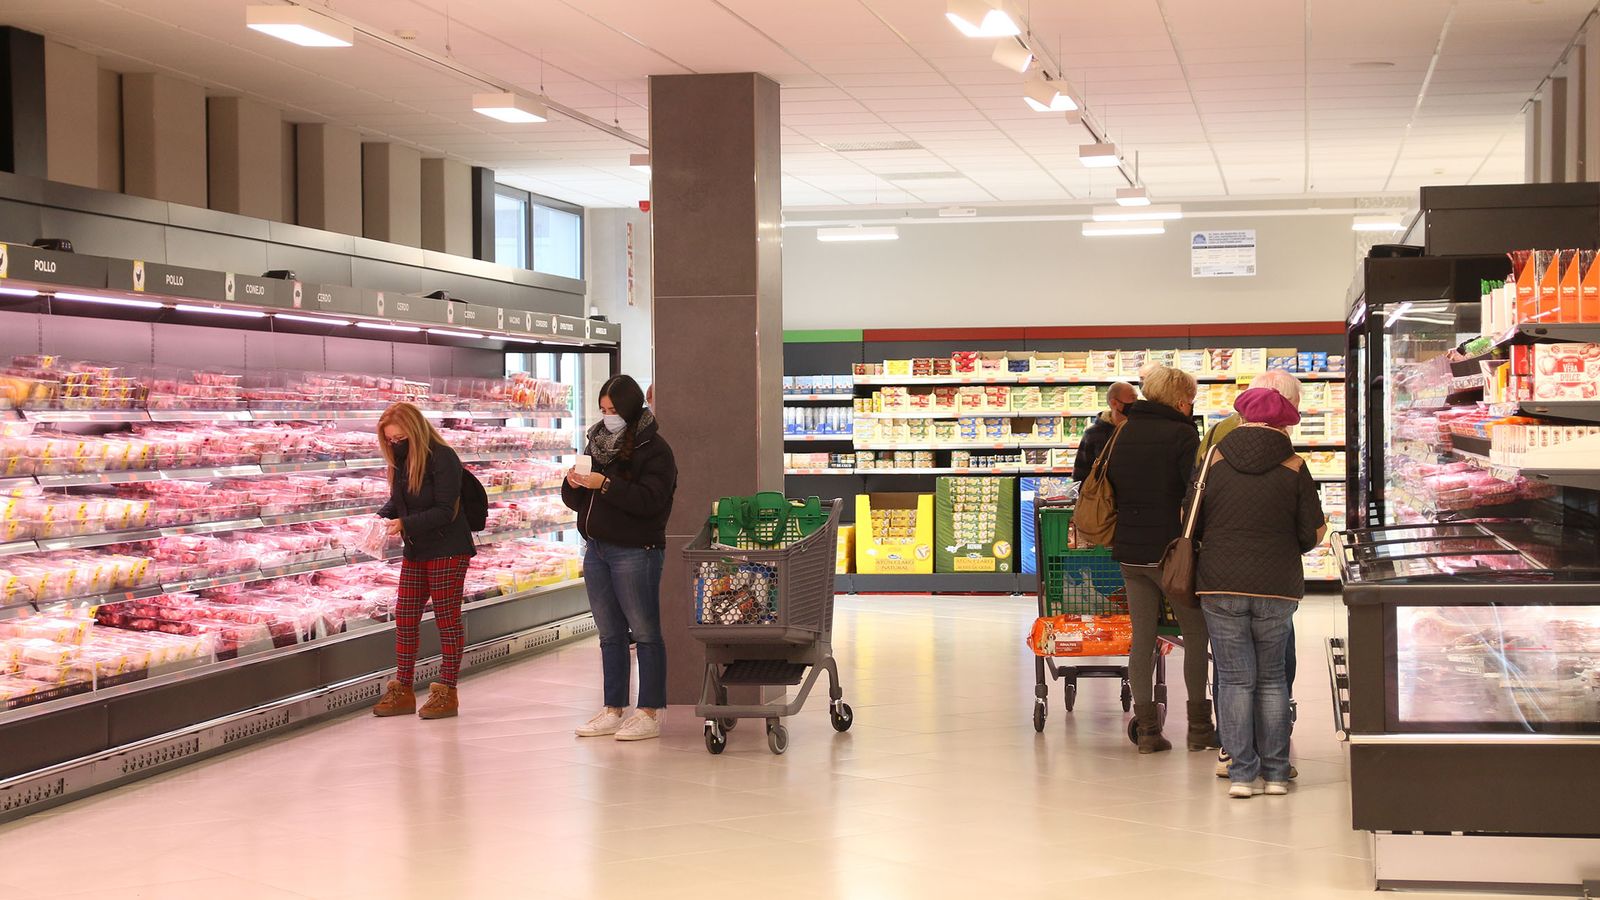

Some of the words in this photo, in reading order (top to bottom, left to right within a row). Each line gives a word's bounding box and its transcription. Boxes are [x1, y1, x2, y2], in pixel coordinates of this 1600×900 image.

[34, 259, 57, 273] POLLO
[165, 274, 184, 286] POLLO
[245, 284, 265, 296] CONEJO
[317, 293, 332, 303] CERDO
[397, 302, 410, 312] CERDO
